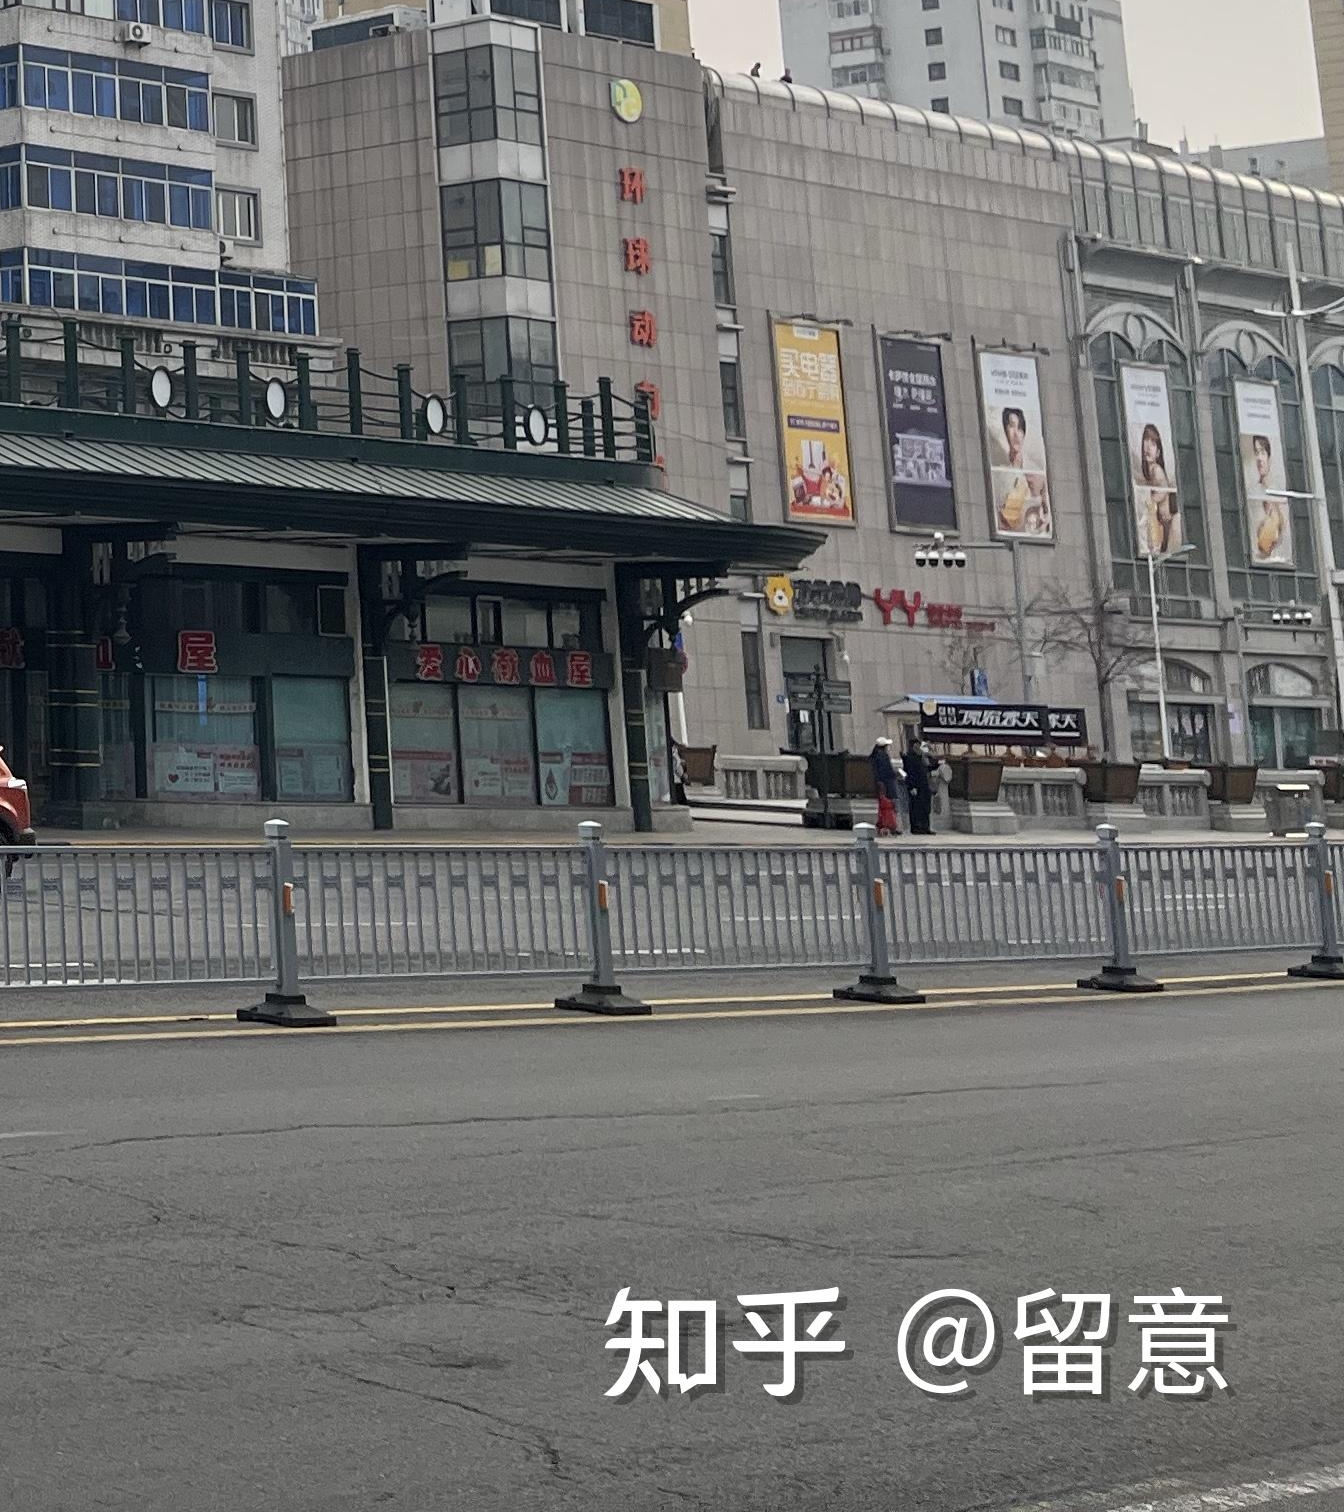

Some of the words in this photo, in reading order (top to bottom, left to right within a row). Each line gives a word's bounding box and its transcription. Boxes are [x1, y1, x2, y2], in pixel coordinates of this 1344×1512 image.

[780, 348, 838, 383] 买电器
[416, 643, 595, 687] 爱心献血屋
